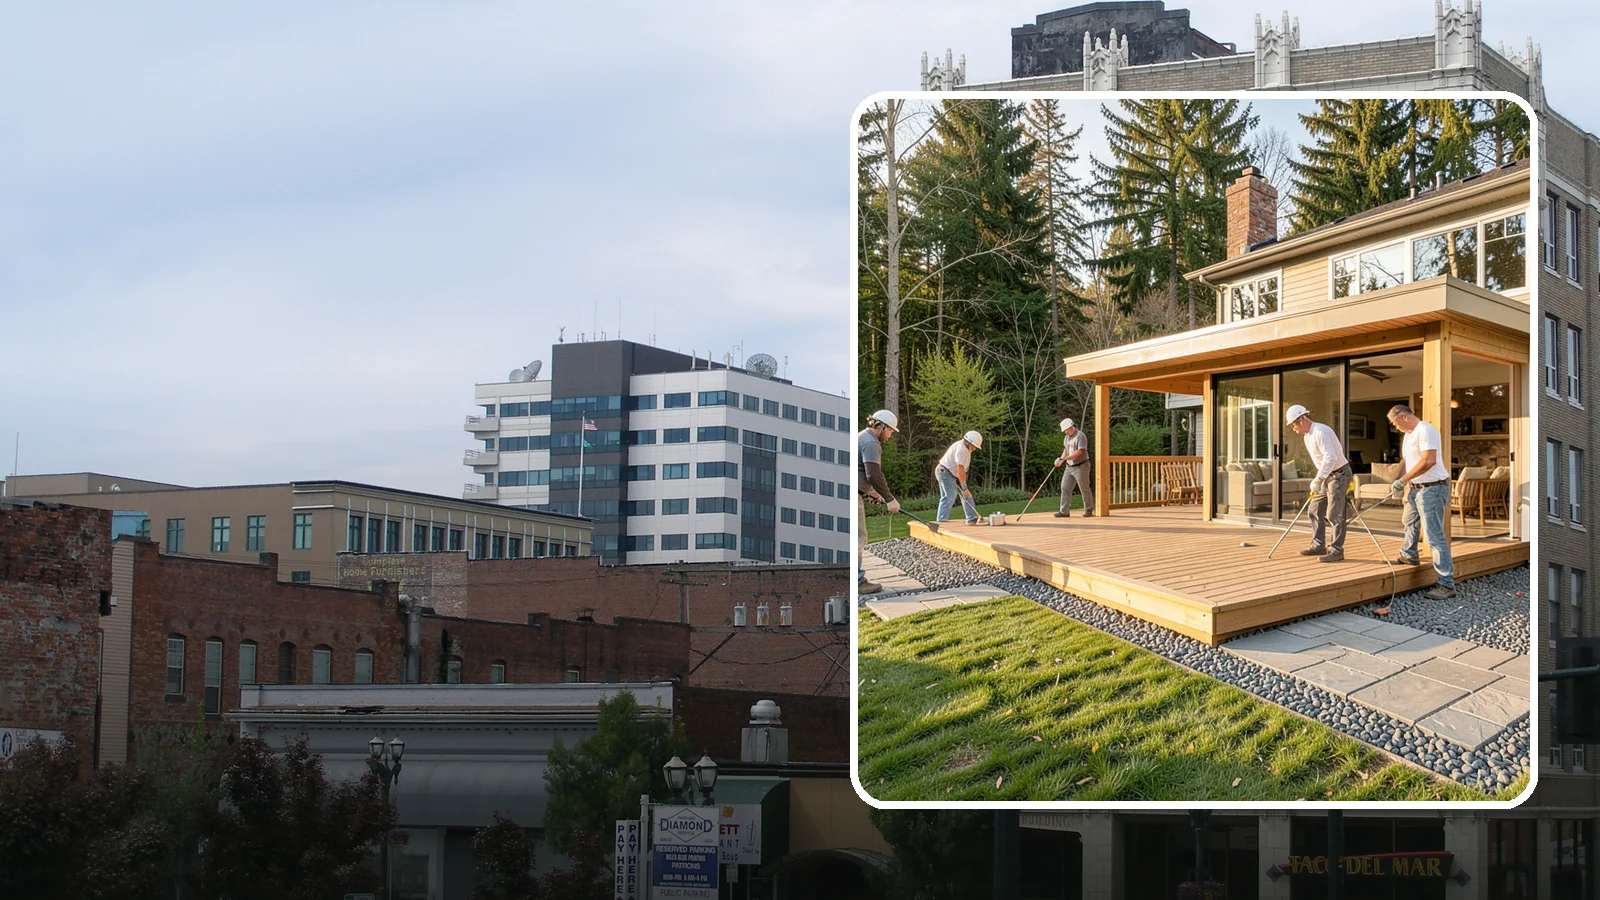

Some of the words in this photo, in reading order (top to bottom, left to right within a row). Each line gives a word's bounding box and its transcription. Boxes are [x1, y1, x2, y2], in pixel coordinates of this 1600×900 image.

[370, 566, 427, 577] Furnishers
[660, 818, 713, 832] DIAMOND
[1022, 815, 1069, 828] BUILDING
[617, 825, 625, 852] PAY
[629, 824, 637, 852] PAY
[656, 845, 688, 853] RESERVED
[689, 846, 716, 854] PARKING
[721, 851, 739, 862] Soup
[671, 862, 701, 870] PATRONS
[1346, 856, 1386, 876] DEL
[1392, 857, 1443, 878] MAR
[628, 856, 636, 893] HERE
[660, 889, 681, 897] PUBLIC
[683, 889, 710, 898] PARKING
